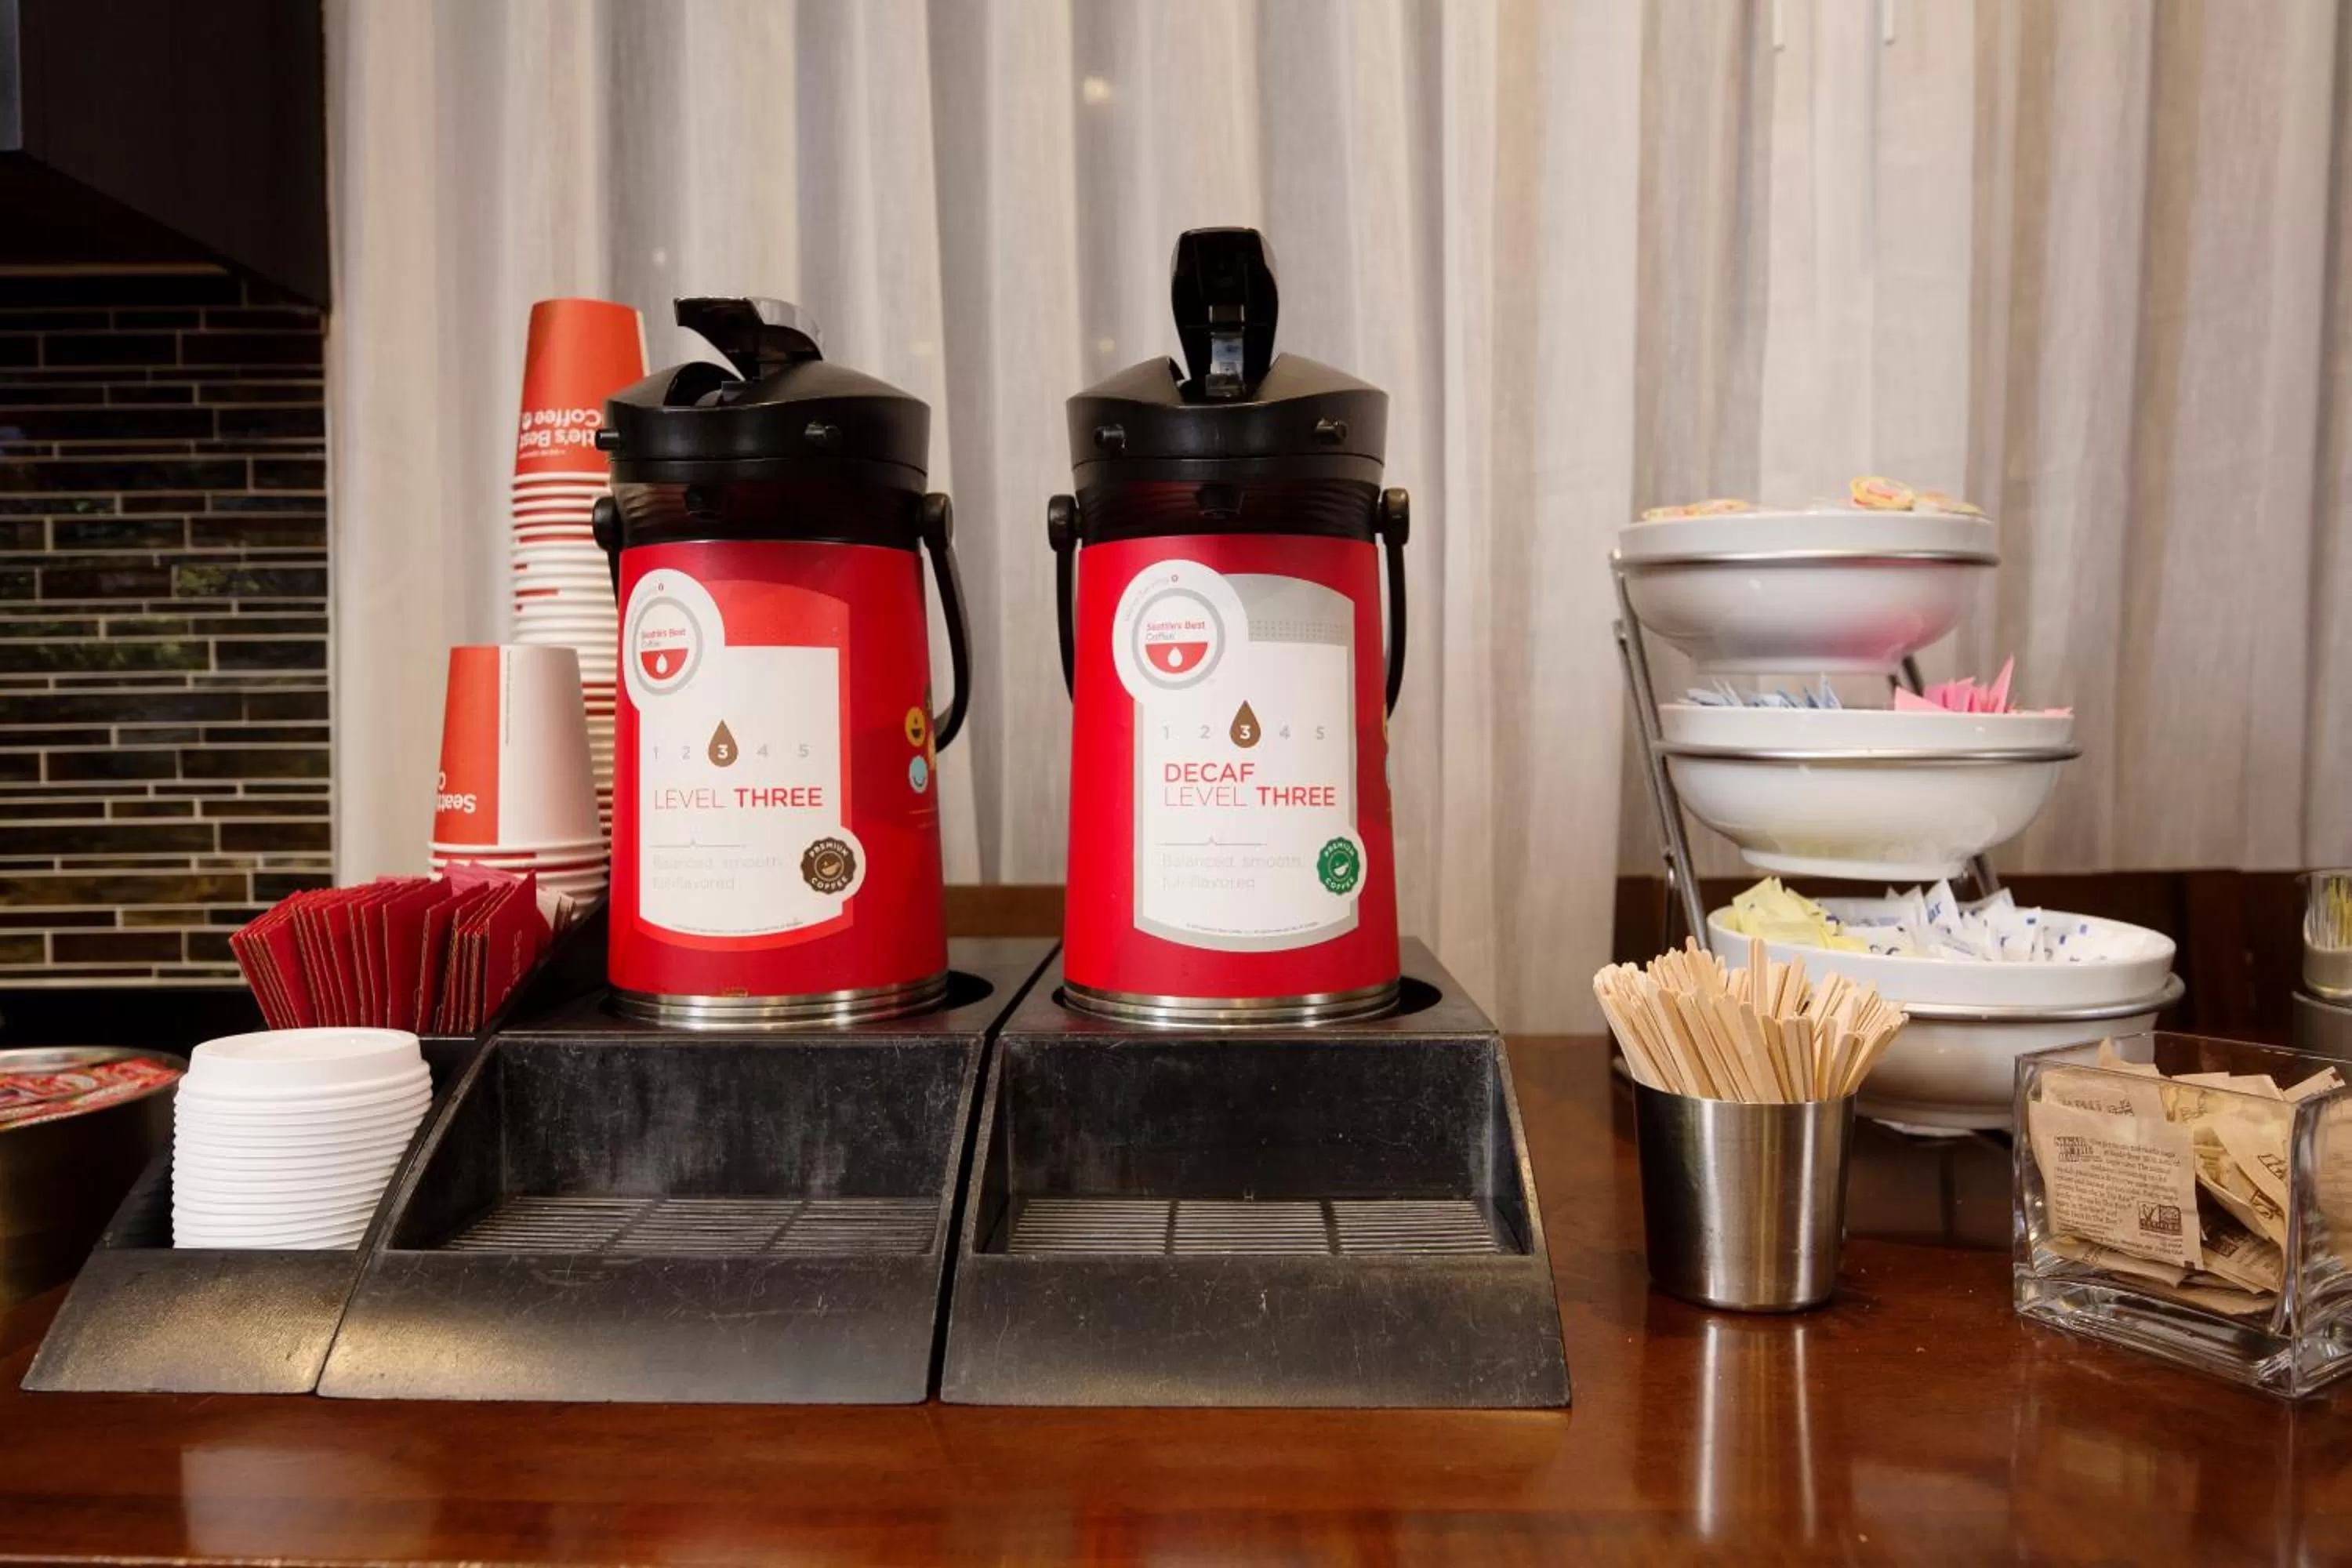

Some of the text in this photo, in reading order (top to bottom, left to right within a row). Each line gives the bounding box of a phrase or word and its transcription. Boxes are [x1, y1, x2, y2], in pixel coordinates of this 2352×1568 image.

[535, 408, 602, 427] Coffee
[555, 428, 596, 447] tle's
[1185, 620, 1206, 630] Best
[1163, 724, 1325, 741] 1 2 3 4 5
[653, 744, 809, 760] 1 2 3 4 5
[1164, 762, 1255, 784] DECAF
[654, 786, 824, 811] LEVEL THREE
[1164, 786, 1337, 808] LEVEL THREE
[808, 840, 849, 858] PREMIUM
[811, 876, 848, 891] COFFEE
